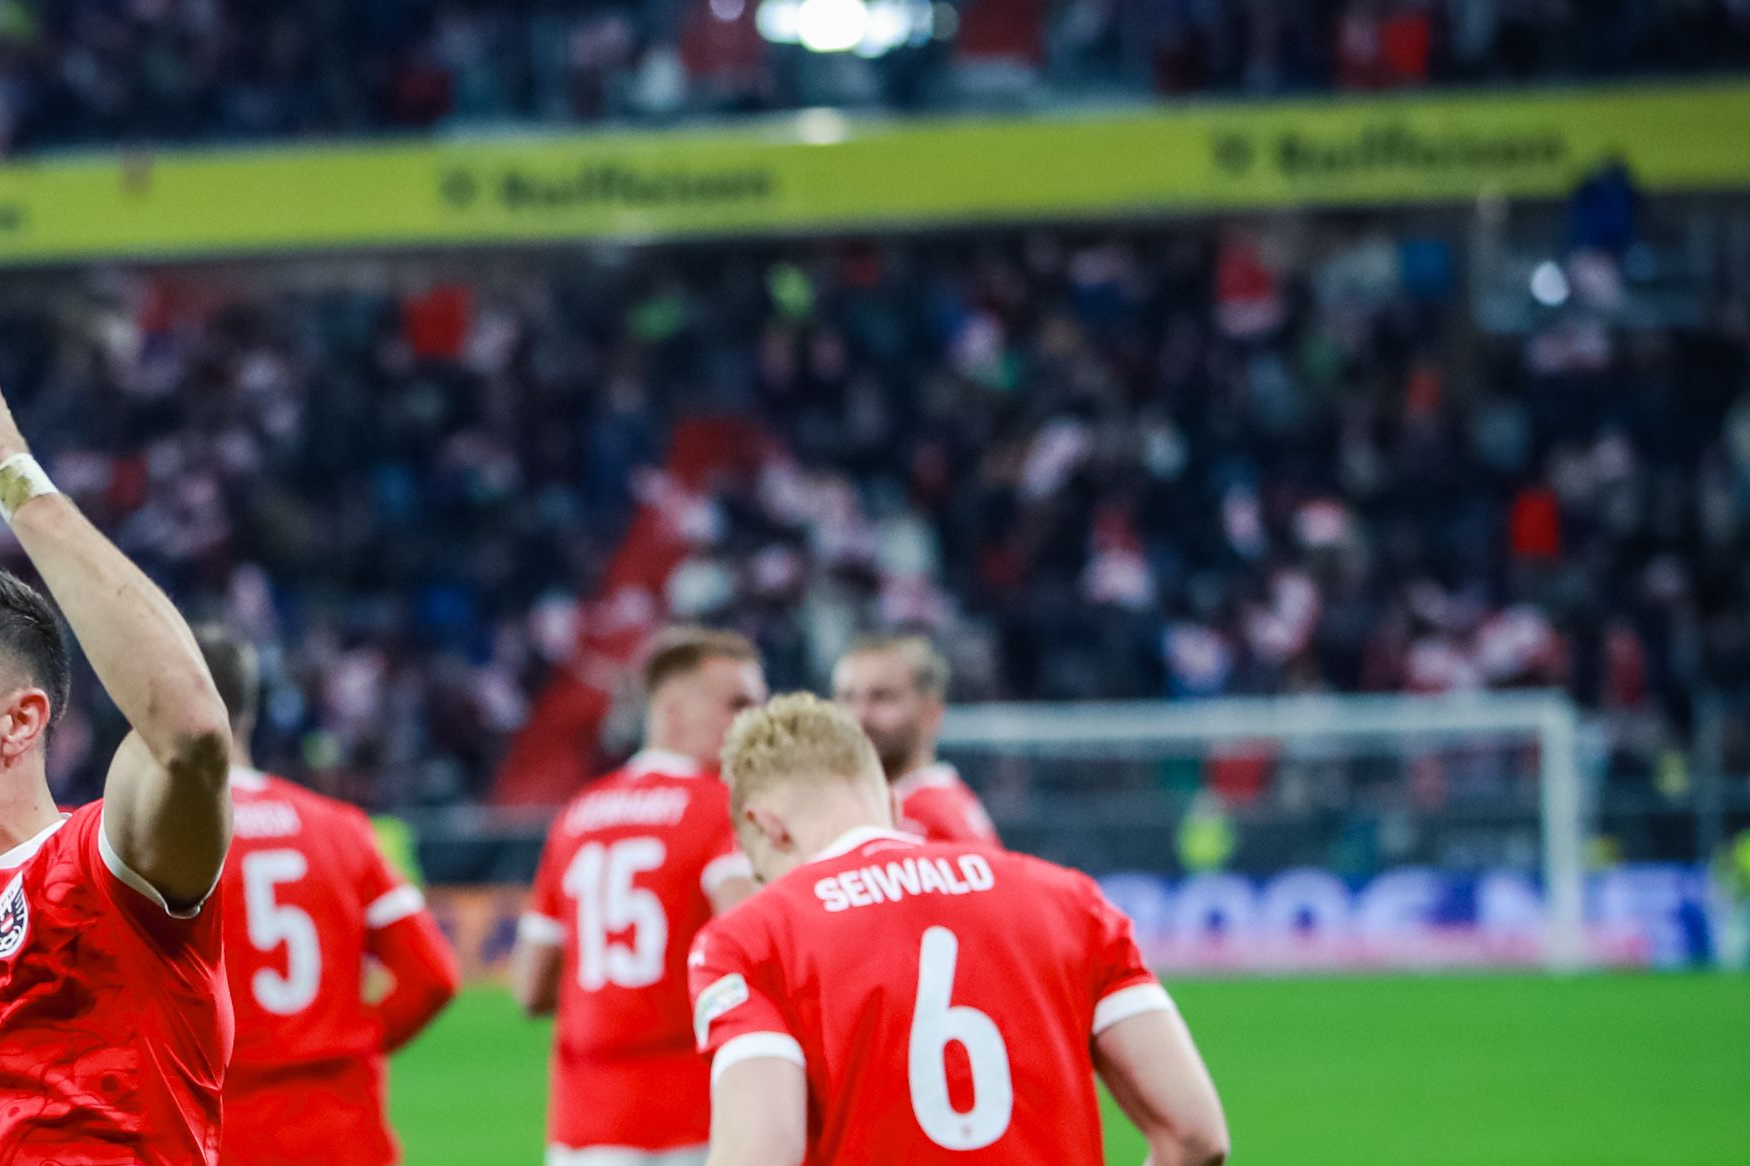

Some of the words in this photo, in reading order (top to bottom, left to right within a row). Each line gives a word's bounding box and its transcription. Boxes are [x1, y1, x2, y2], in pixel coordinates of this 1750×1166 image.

[241, 847, 322, 1015] 5
[562, 836, 668, 991] 15
[814, 853, 995, 912] SEIWALD
[908, 925, 1014, 1151] 6
